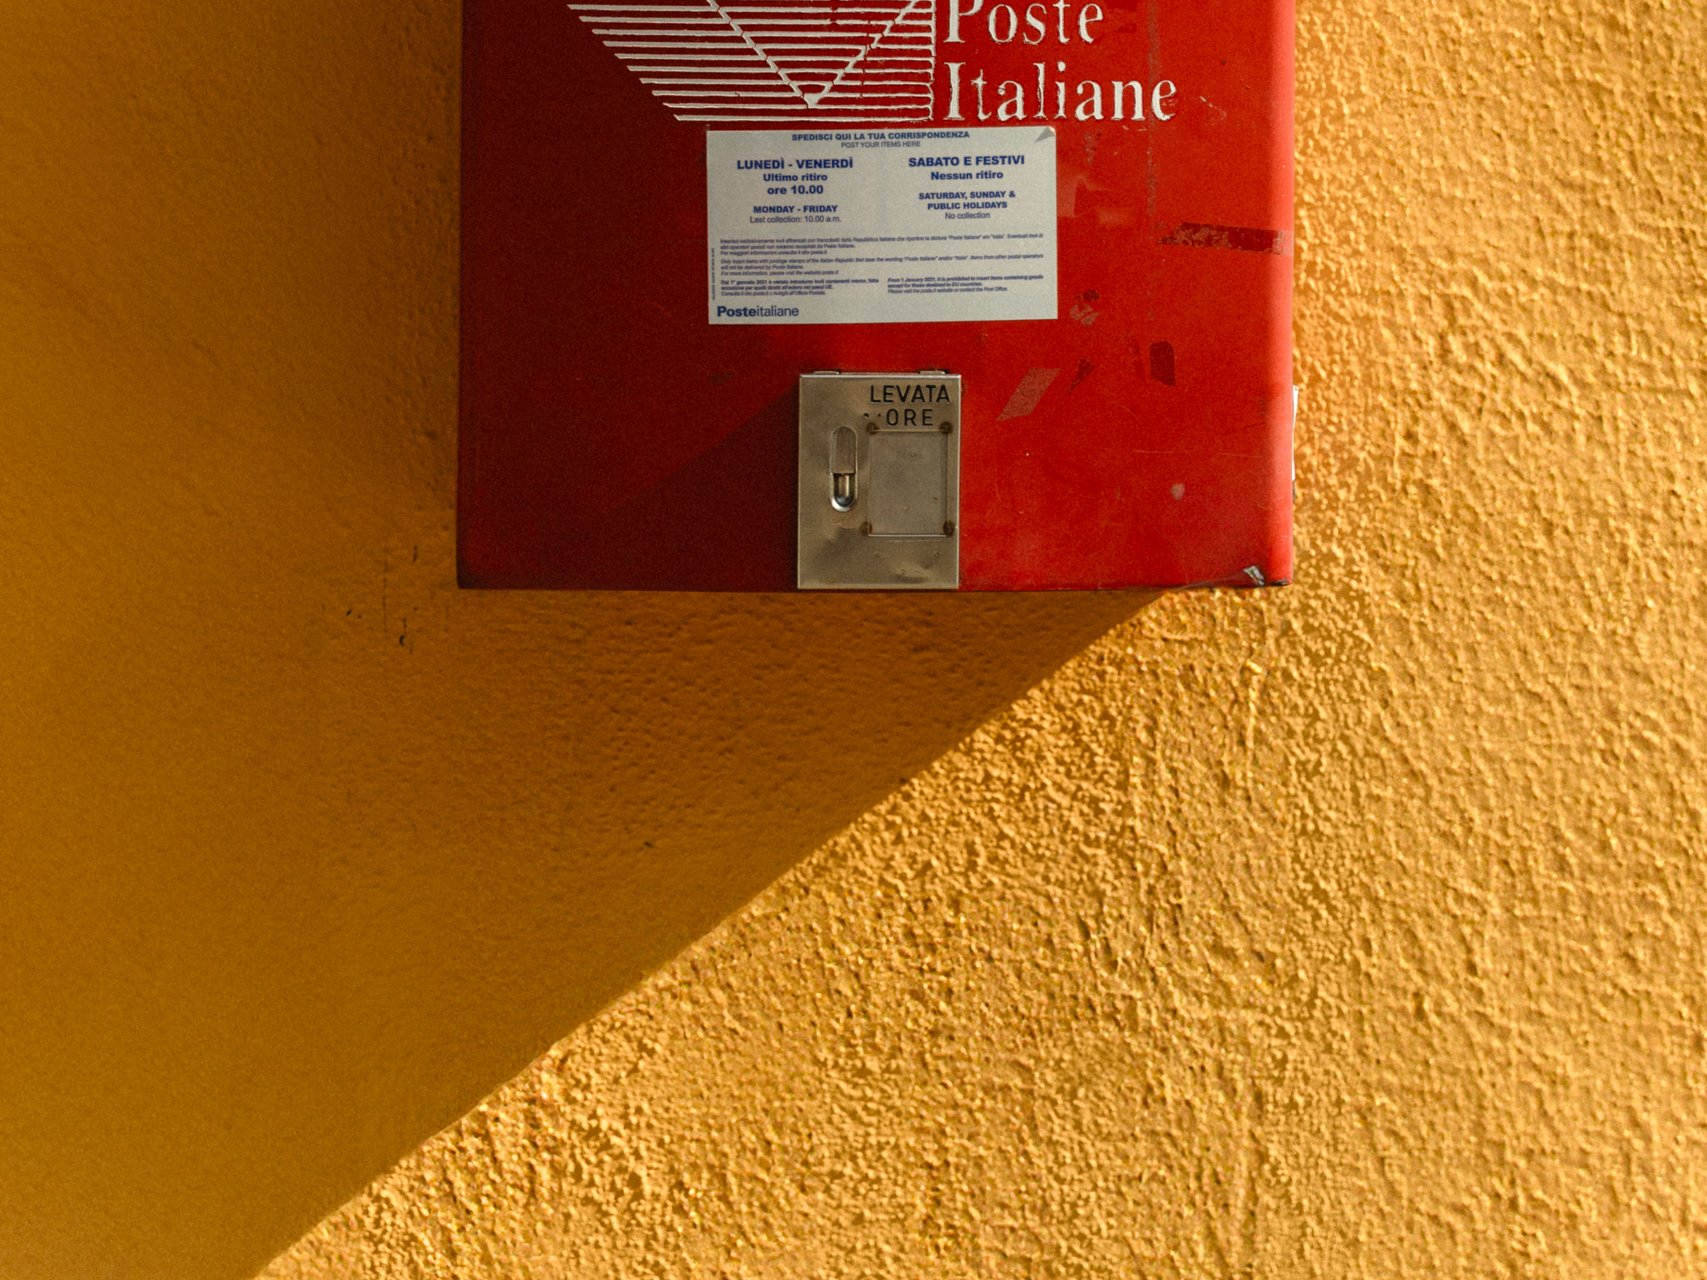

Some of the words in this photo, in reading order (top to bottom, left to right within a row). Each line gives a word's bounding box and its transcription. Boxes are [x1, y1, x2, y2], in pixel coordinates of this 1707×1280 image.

[946, 60, 1178, 123] Italiane
[792, 133, 833, 141] SPEDISCI
[836, 133, 851, 141] QUI
[867, 132, 885, 140] TUA
[888, 131, 970, 140] CORRISPONDENZA
[737, 157, 785, 170] LUNEDÌ
[795, 156, 854, 169] VENERDÌ
[908, 156, 960, 167] SABATO
[963, 156, 972, 166] E
[976, 155, 1025, 166] FESTIVI
[763, 173, 798, 182] Ultimo
[801, 173, 828, 181] ritiro
[930, 171, 973, 180] Nessun
[976, 170, 1004, 179] ritiro
[767, 187, 787, 195] ore
[791, 185, 824, 195] 10.00
[918, 191, 968, 200] SATURDAY,
[969, 191, 1006, 199] SUNDAY
[1009, 190, 1016, 198] &
[753, 205, 795, 213] MONDAY
[803, 204, 838, 213] FRIDAY
[927, 202, 961, 210] PUBLIC
[963, 201, 1008, 209] HOLIDAYS
[767, 215, 803, 223] collection:
[804, 215, 825, 223] 10.00
[717, 305, 799, 317] Posteitaliane
[870, 384, 951, 403] LEVATA
[886, 408, 934, 426] ORE
